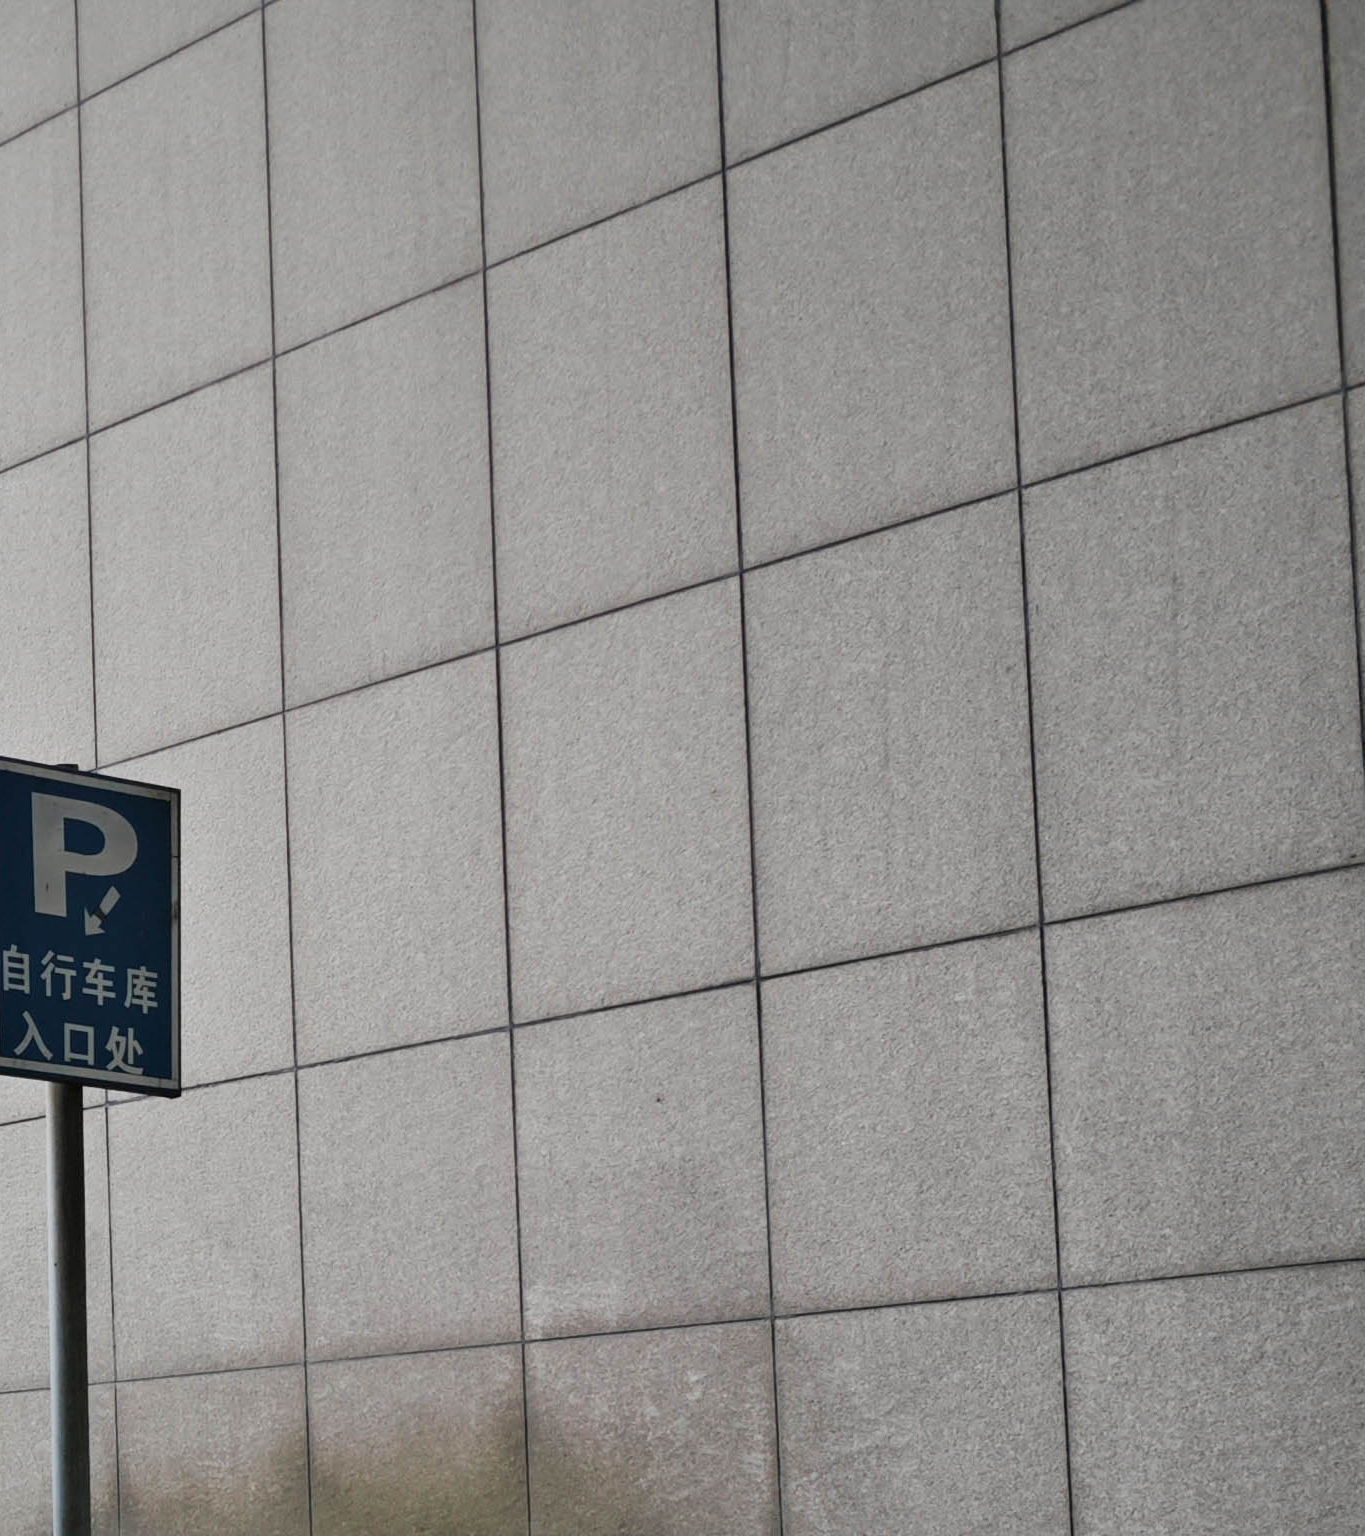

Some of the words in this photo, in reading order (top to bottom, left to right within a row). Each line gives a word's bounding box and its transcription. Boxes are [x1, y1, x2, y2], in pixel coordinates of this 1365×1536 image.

[31, 791, 138, 918] P
[1, 943, 159, 1015] 自行车库
[13, 1010, 144, 1077] 入口处
